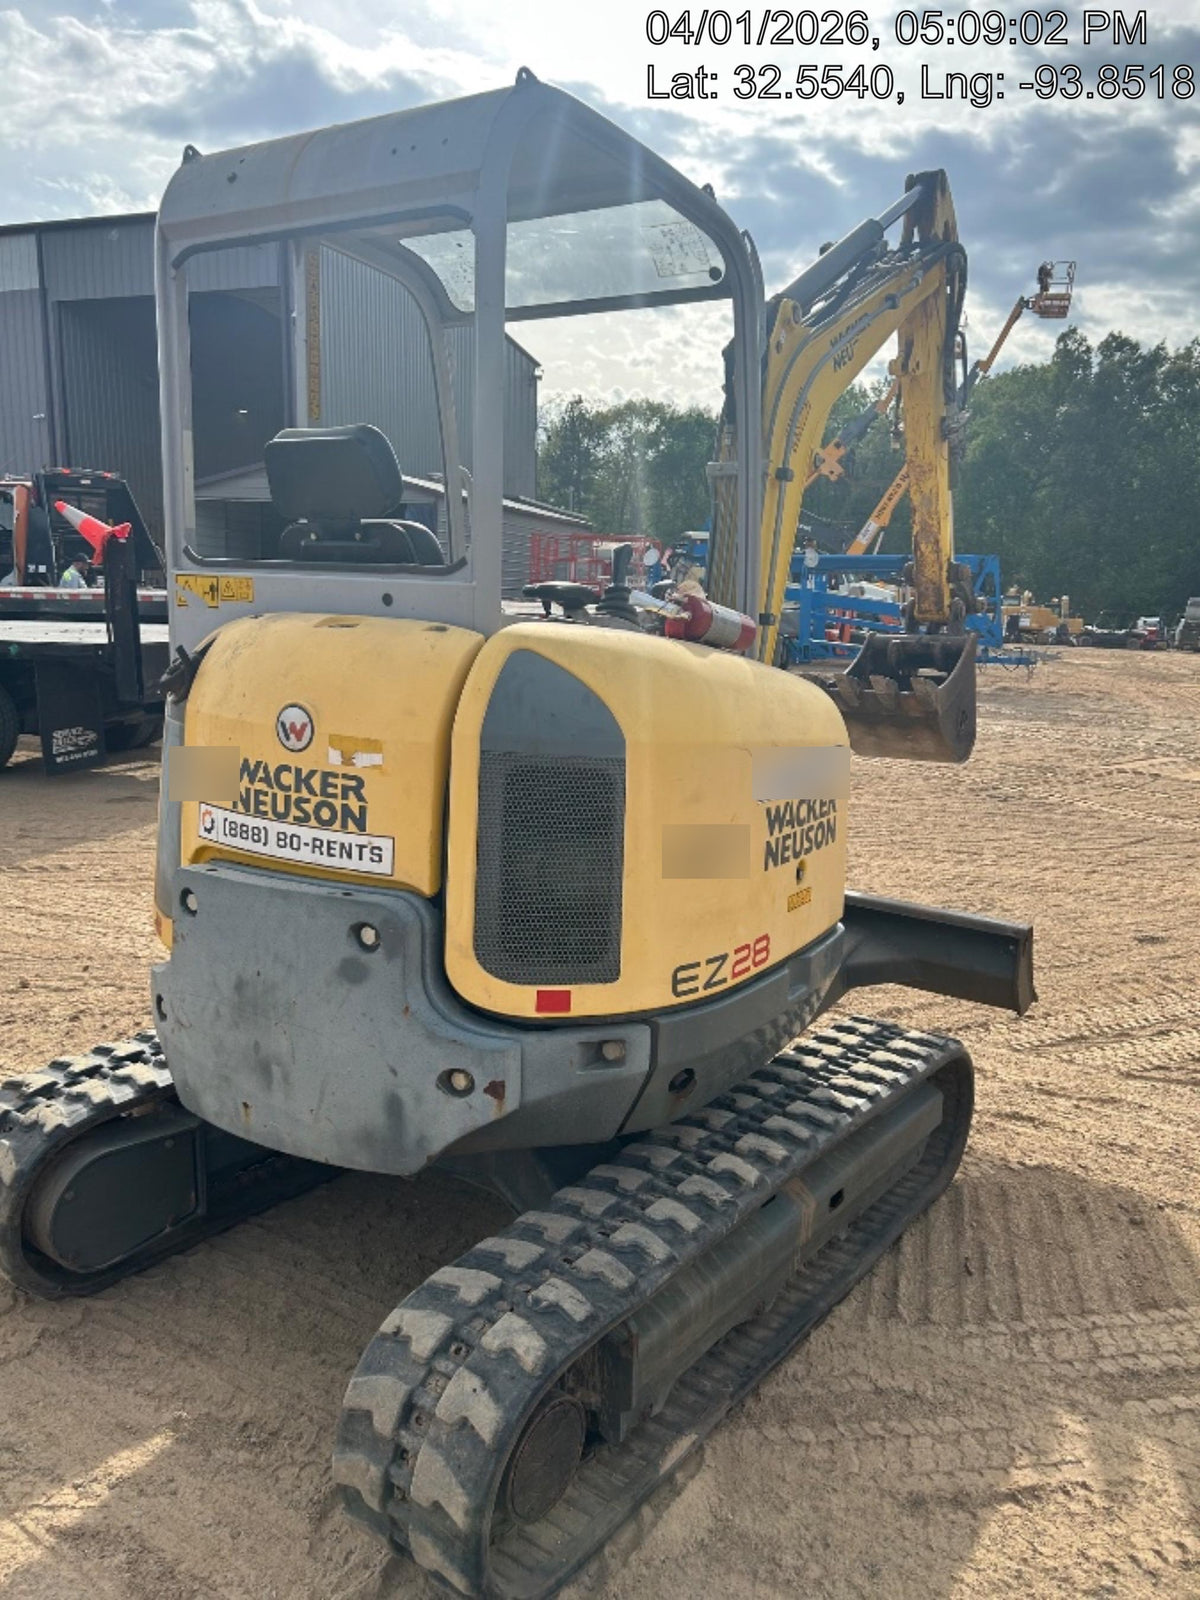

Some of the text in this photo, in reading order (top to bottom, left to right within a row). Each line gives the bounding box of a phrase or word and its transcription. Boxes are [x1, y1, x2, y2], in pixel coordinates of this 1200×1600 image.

[232, 787, 367, 832] NEUSON
[223, 817, 383, 864] (888) 80-RENTS
[764, 815, 837, 872] NEUSON
[672, 933, 770, 998] EZ28
